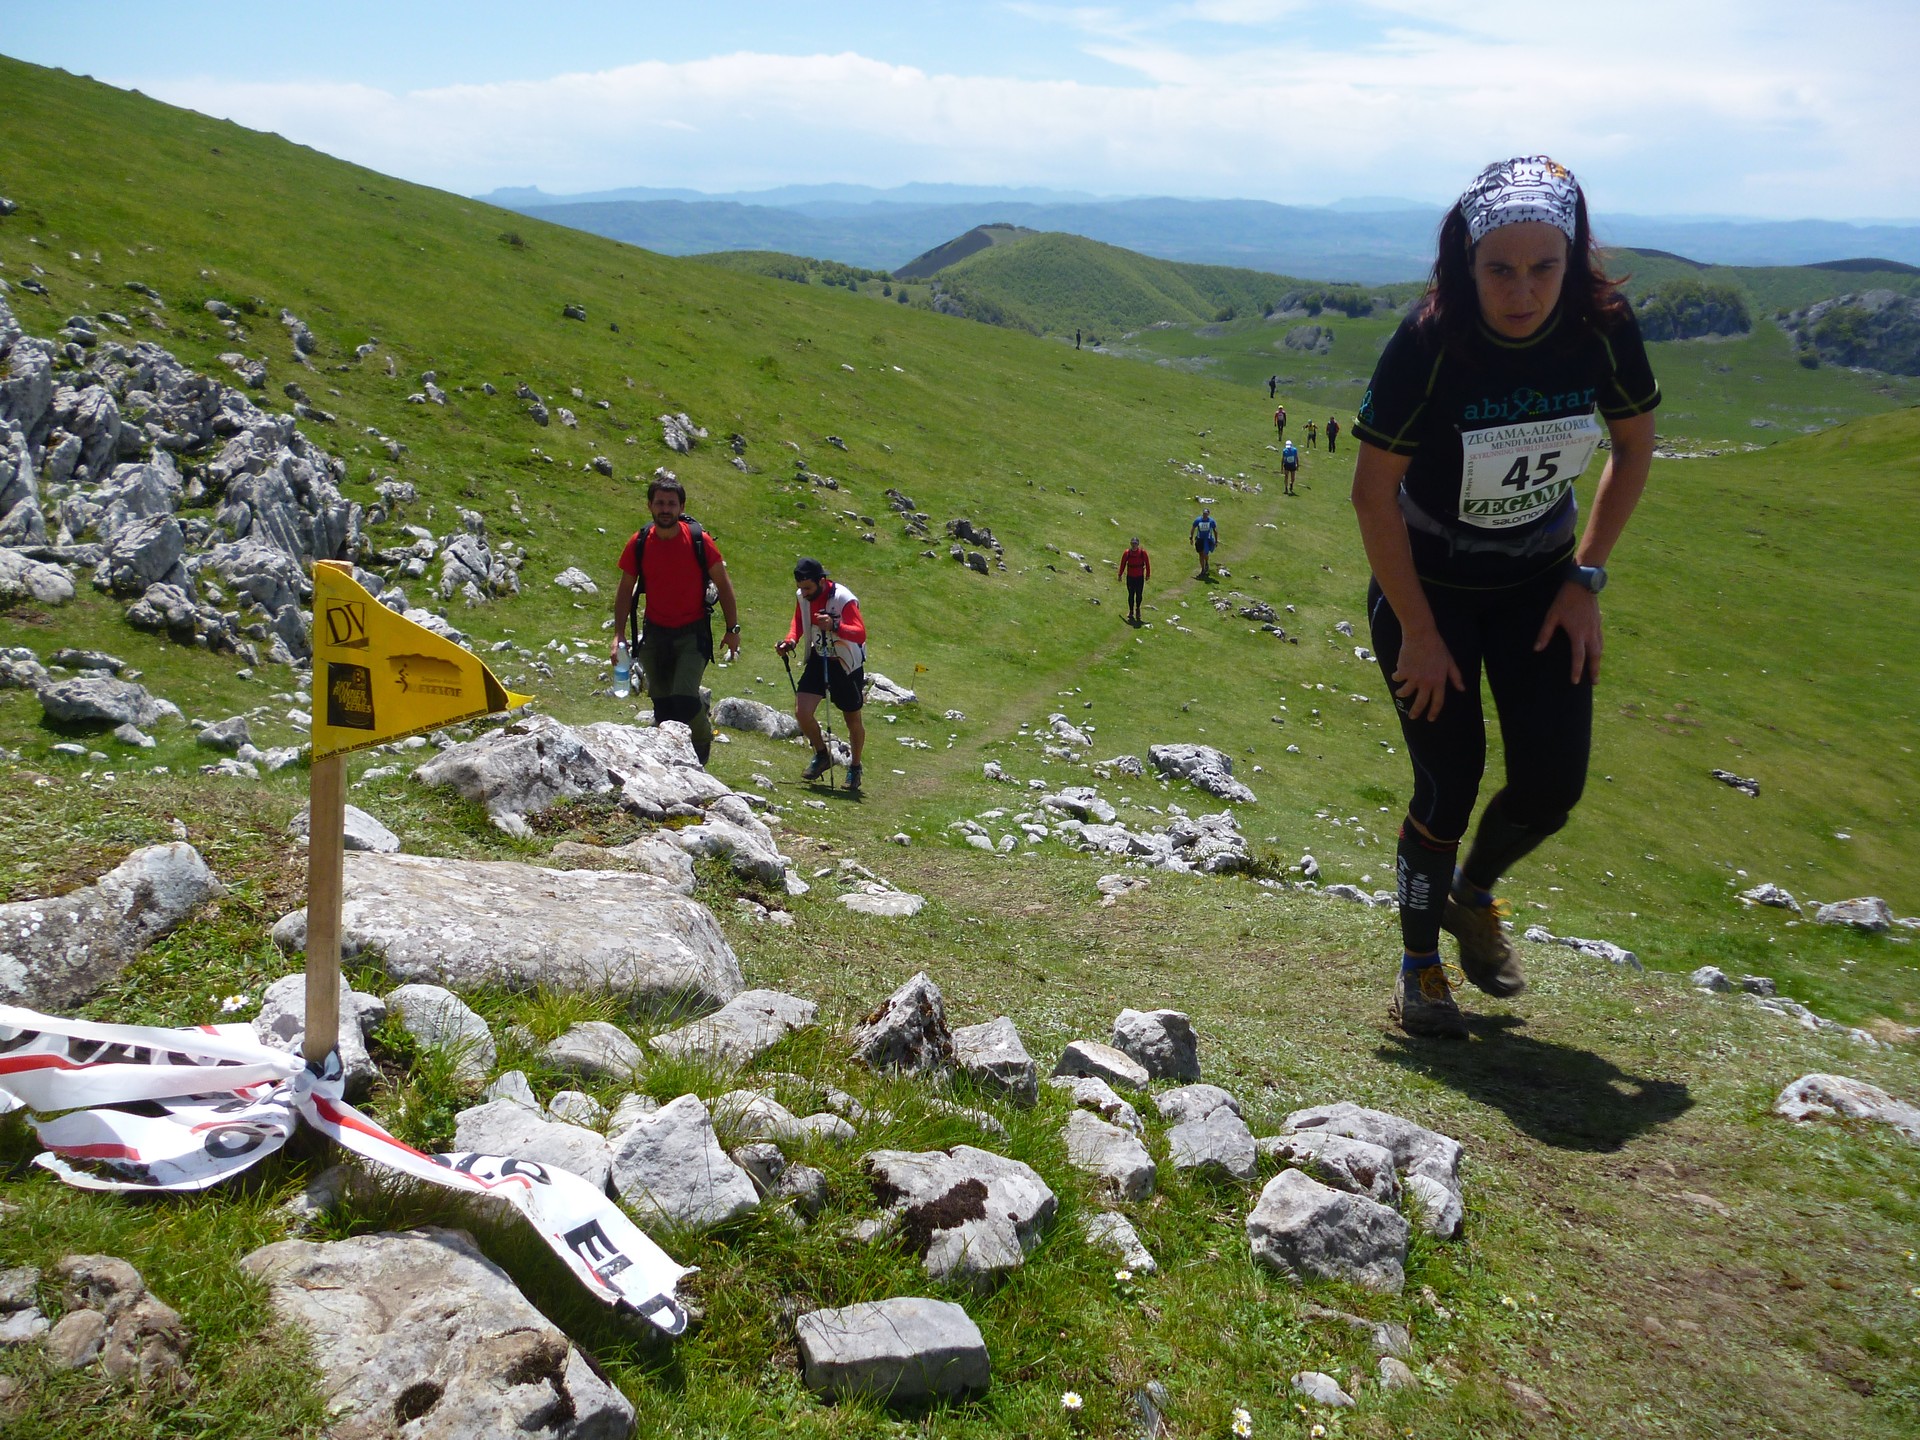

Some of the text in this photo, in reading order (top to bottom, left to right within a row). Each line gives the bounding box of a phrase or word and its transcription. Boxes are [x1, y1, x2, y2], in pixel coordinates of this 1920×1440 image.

[1467, 418, 1590, 445] ZEGAMA-AIZKORRI
[1491, 432, 1572, 451] MENDI MARATOIA
[1501, 451, 1561, 491] 45
[345, 703, 372, 713] SERIES
